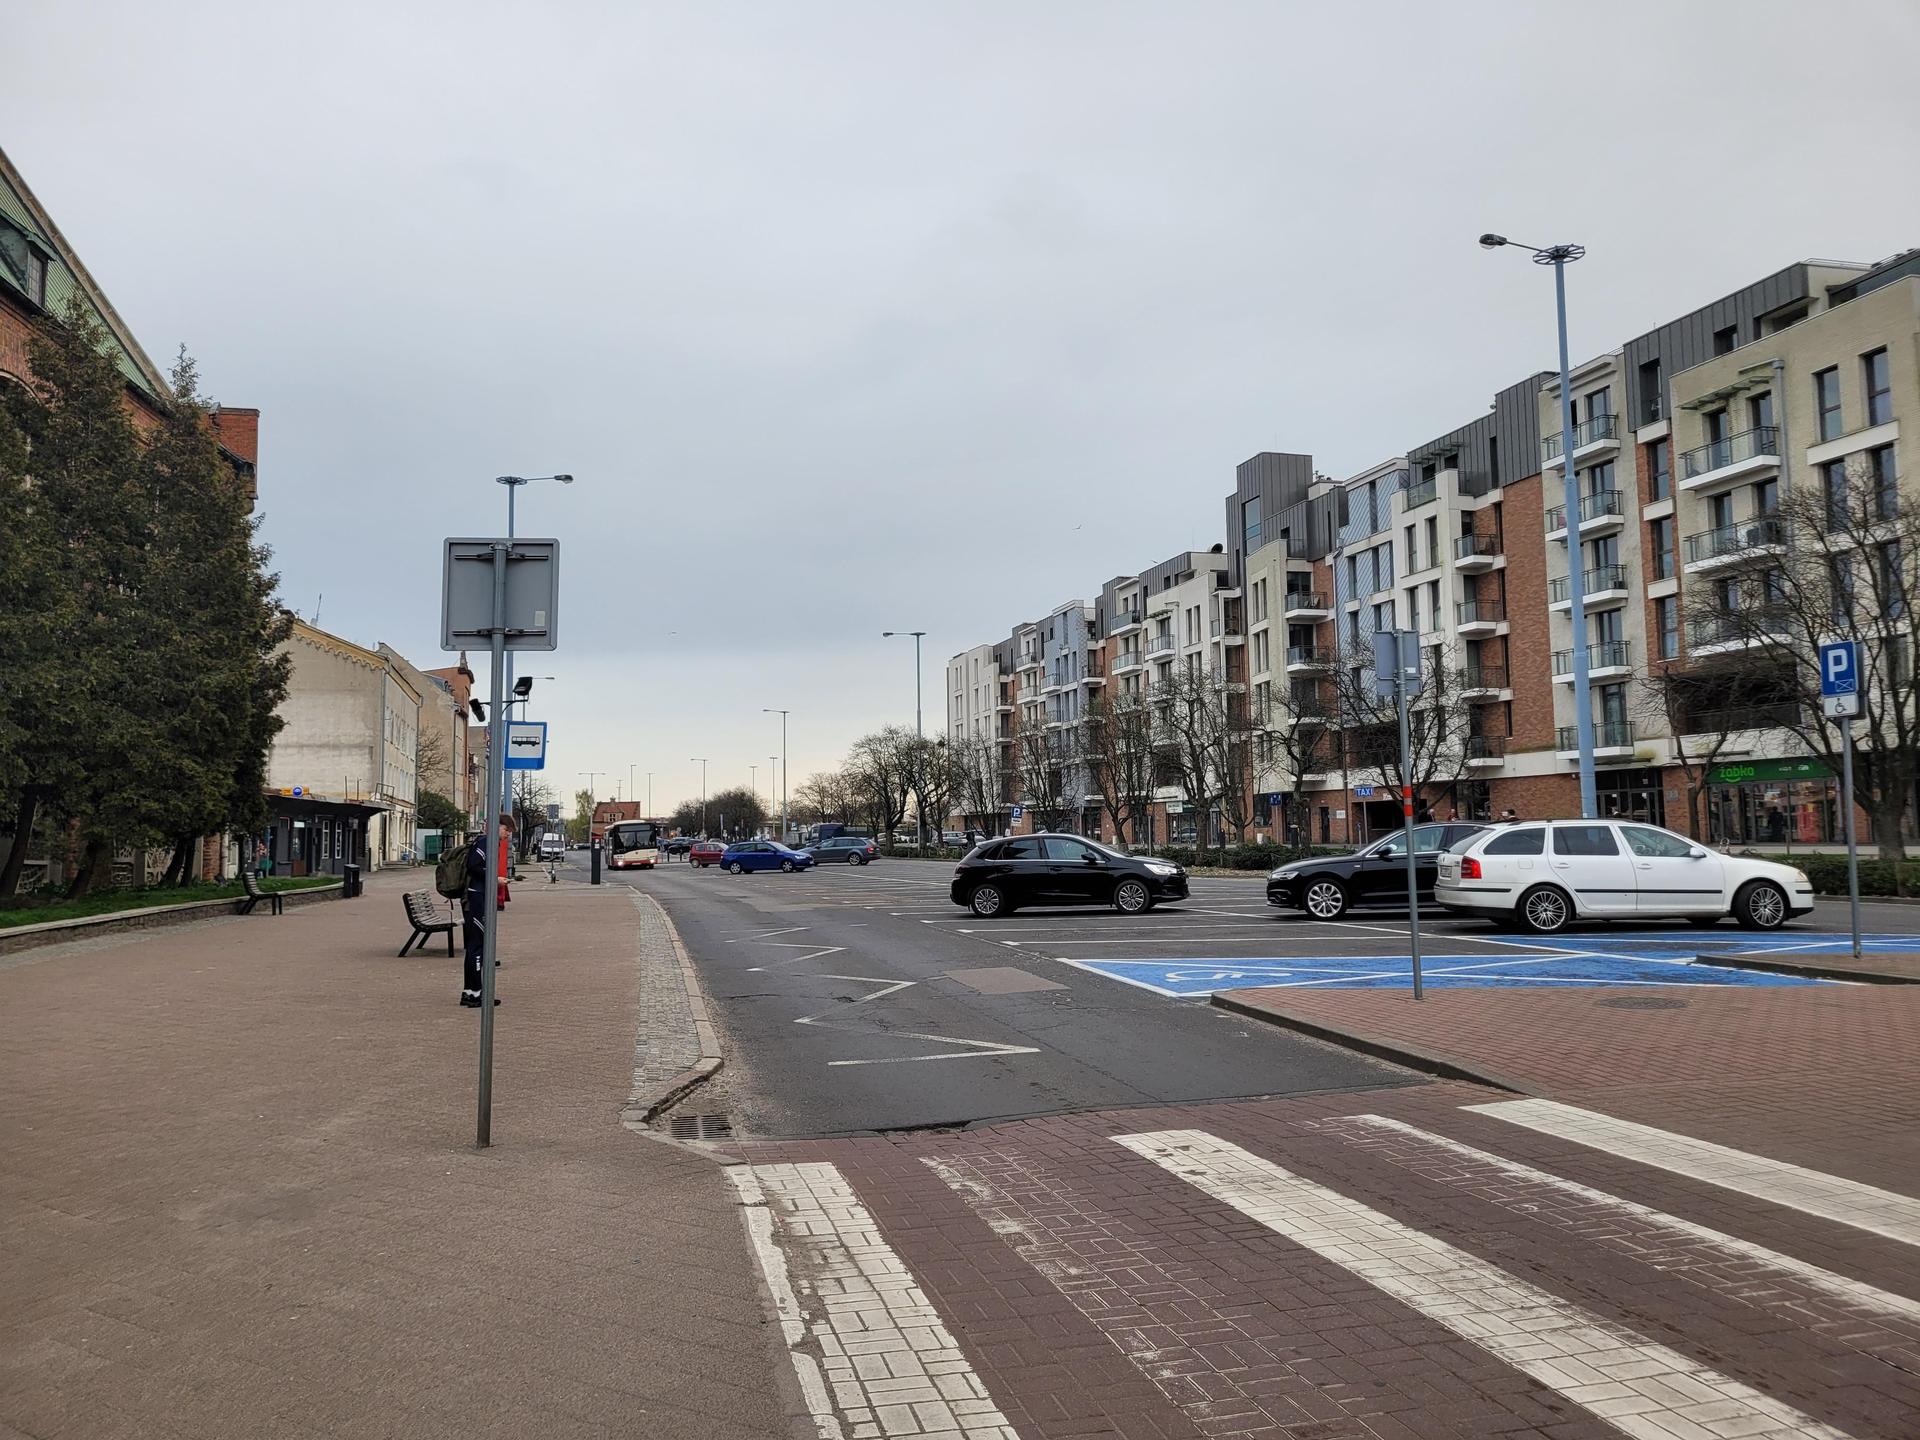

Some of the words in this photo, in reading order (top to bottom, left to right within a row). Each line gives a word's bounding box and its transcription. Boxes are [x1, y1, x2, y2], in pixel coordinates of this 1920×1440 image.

[1827, 649, 1848, 682] P
[1356, 788, 1373, 796] TAXI
[1013, 807, 1021, 817] P
